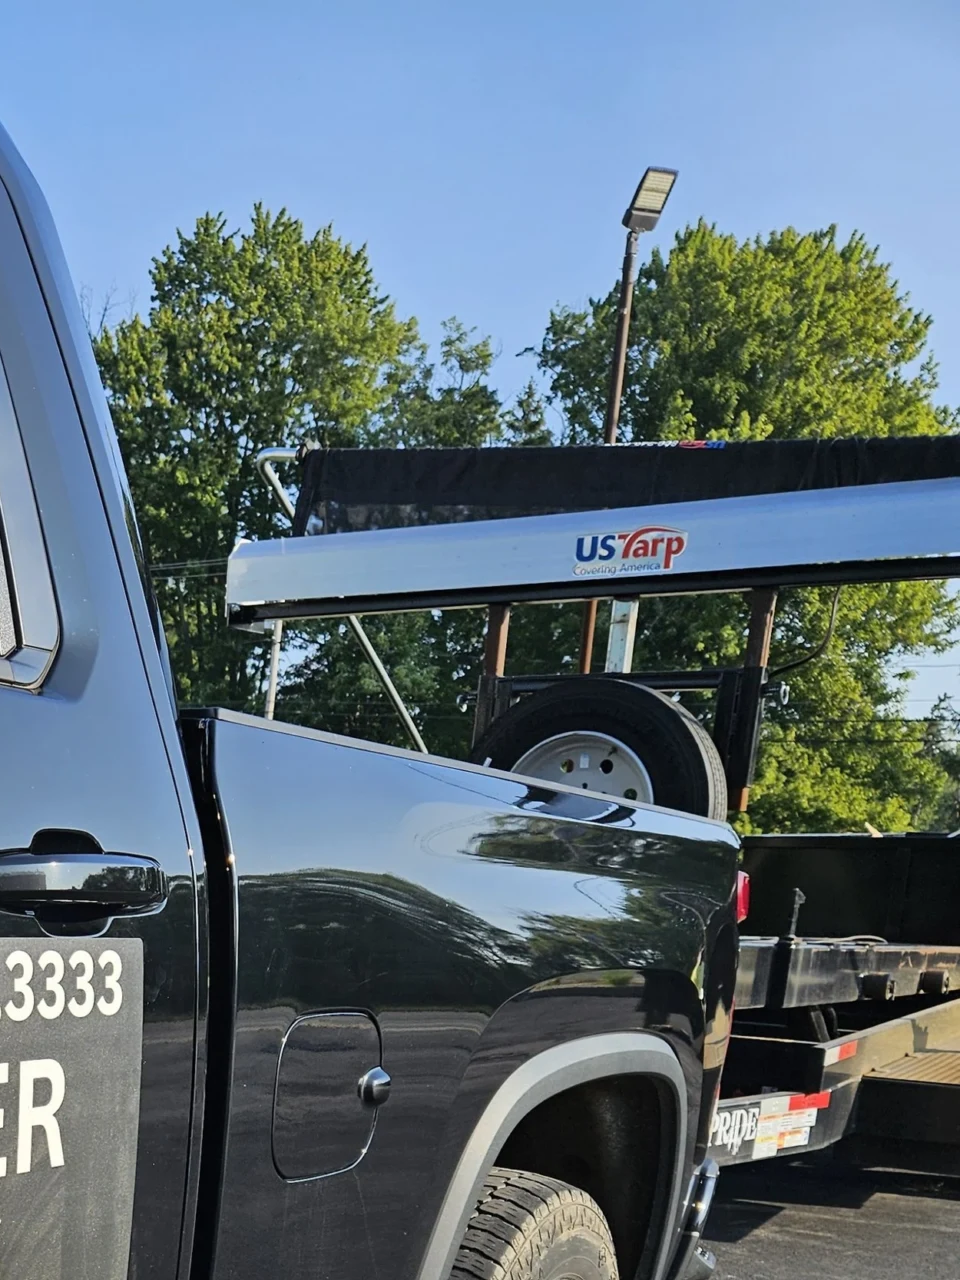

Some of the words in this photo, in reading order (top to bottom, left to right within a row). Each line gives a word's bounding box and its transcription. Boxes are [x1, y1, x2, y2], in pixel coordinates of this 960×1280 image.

[573, 564, 617, 576] Covering
[620, 562, 661, 573] America
[708, 1107, 760, 1156] PRIDE
